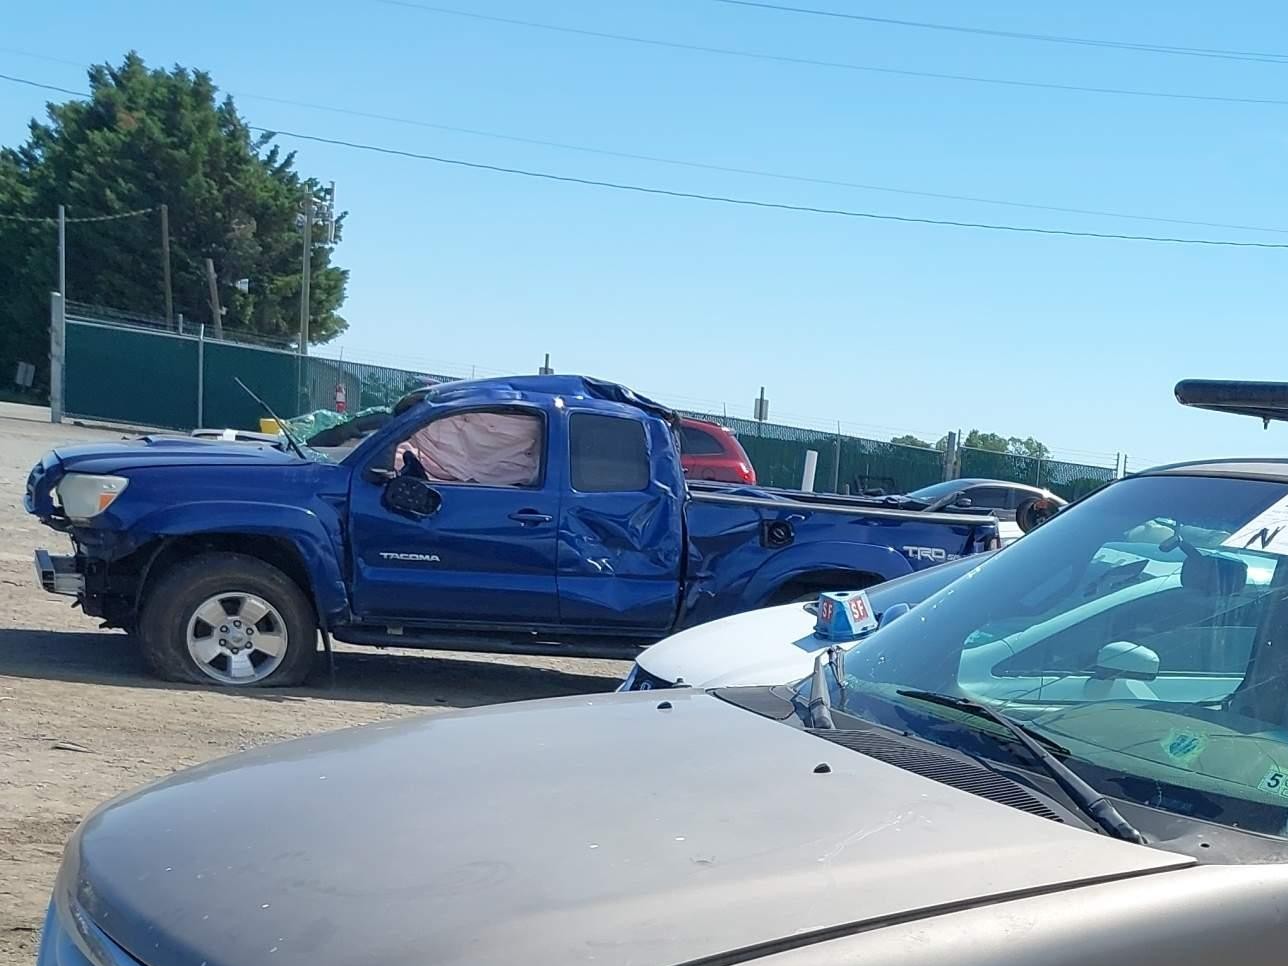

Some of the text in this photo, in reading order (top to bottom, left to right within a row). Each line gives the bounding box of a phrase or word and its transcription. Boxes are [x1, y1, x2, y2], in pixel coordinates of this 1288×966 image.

[379, 552, 441, 562] TACOMA
[902, 545, 946, 562] TRD
[822, 602, 833, 618] SF
[851, 599, 865, 619] SF
[1267, 773, 1283, 788] 5
